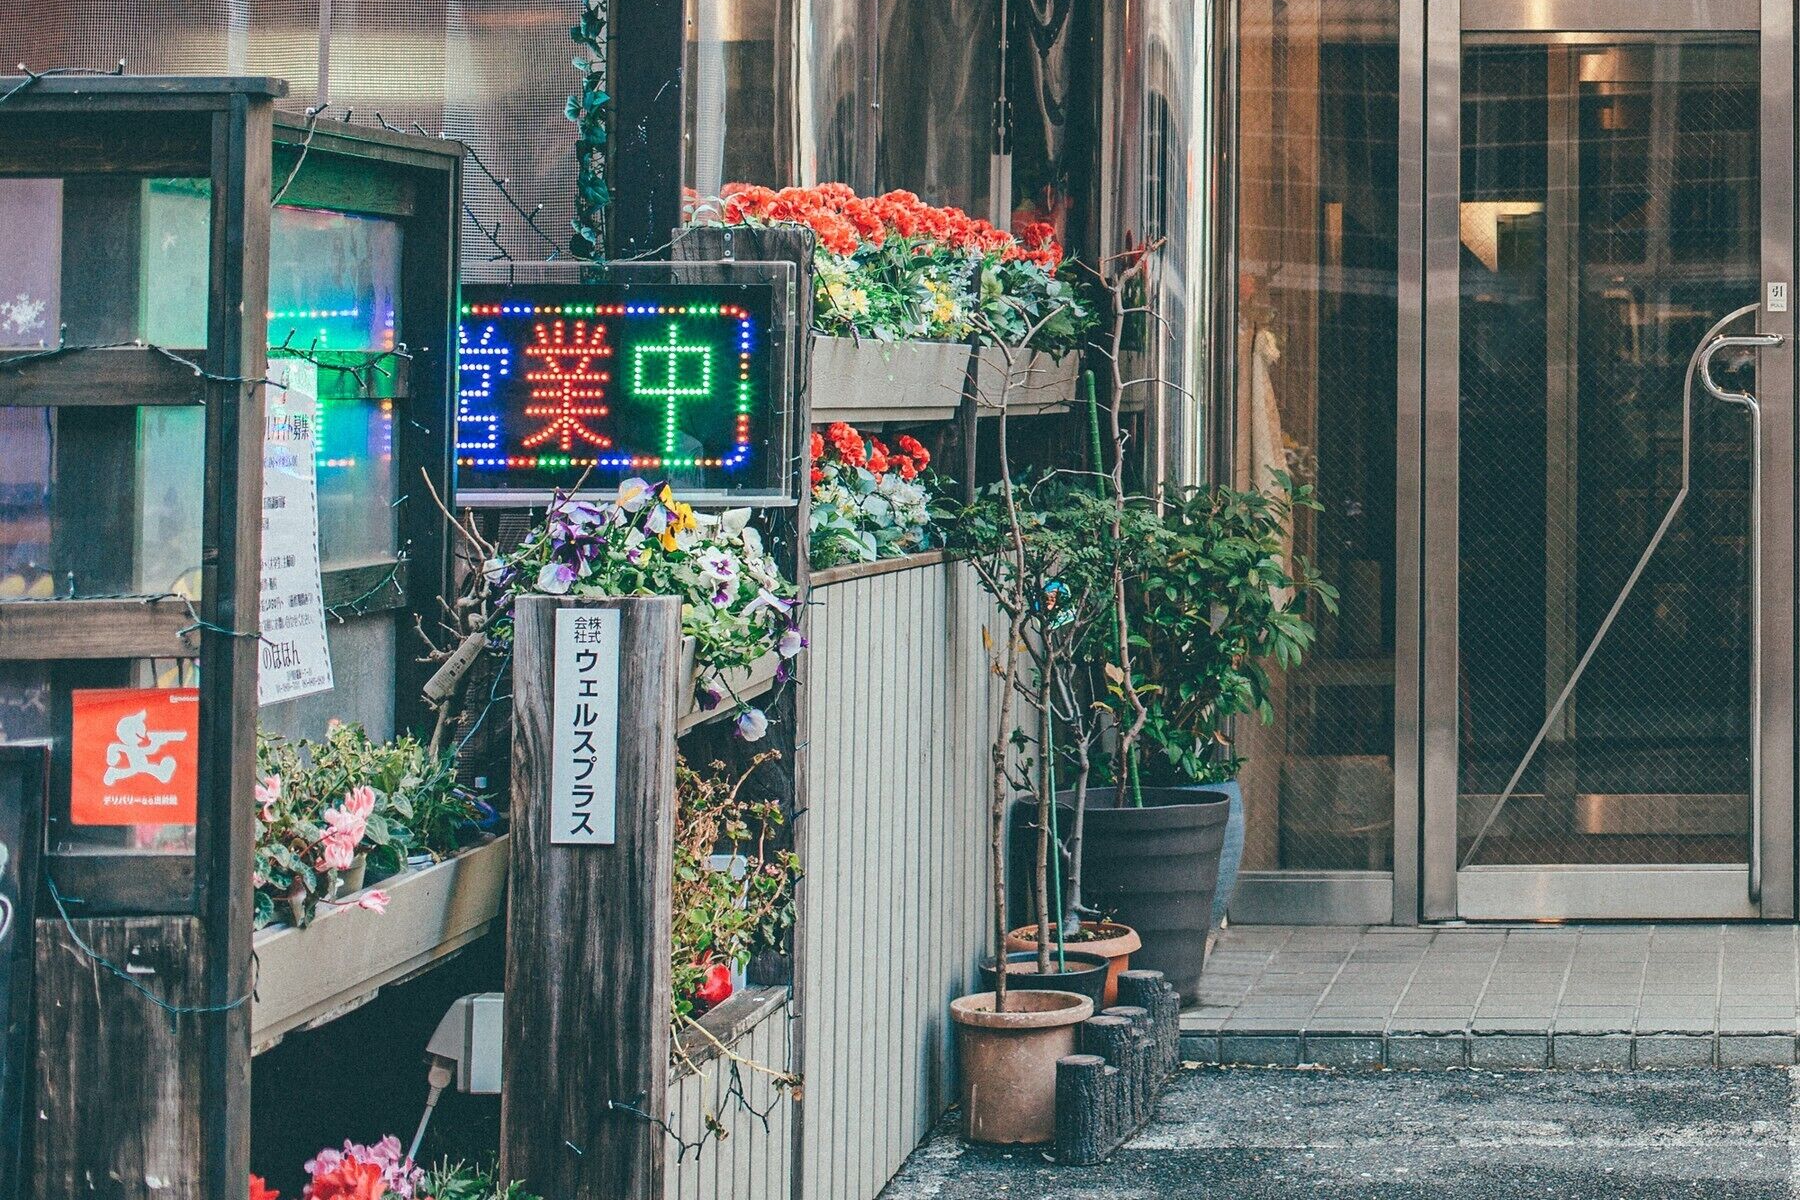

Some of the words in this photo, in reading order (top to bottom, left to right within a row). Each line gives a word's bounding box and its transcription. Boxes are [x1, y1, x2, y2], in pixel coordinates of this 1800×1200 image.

[1772, 285, 1783, 298] 引
[457, 318, 713, 452] 営業中
[262, 640, 301, 670] のほほん
[570, 648, 599, 836] ウェルスプラス
